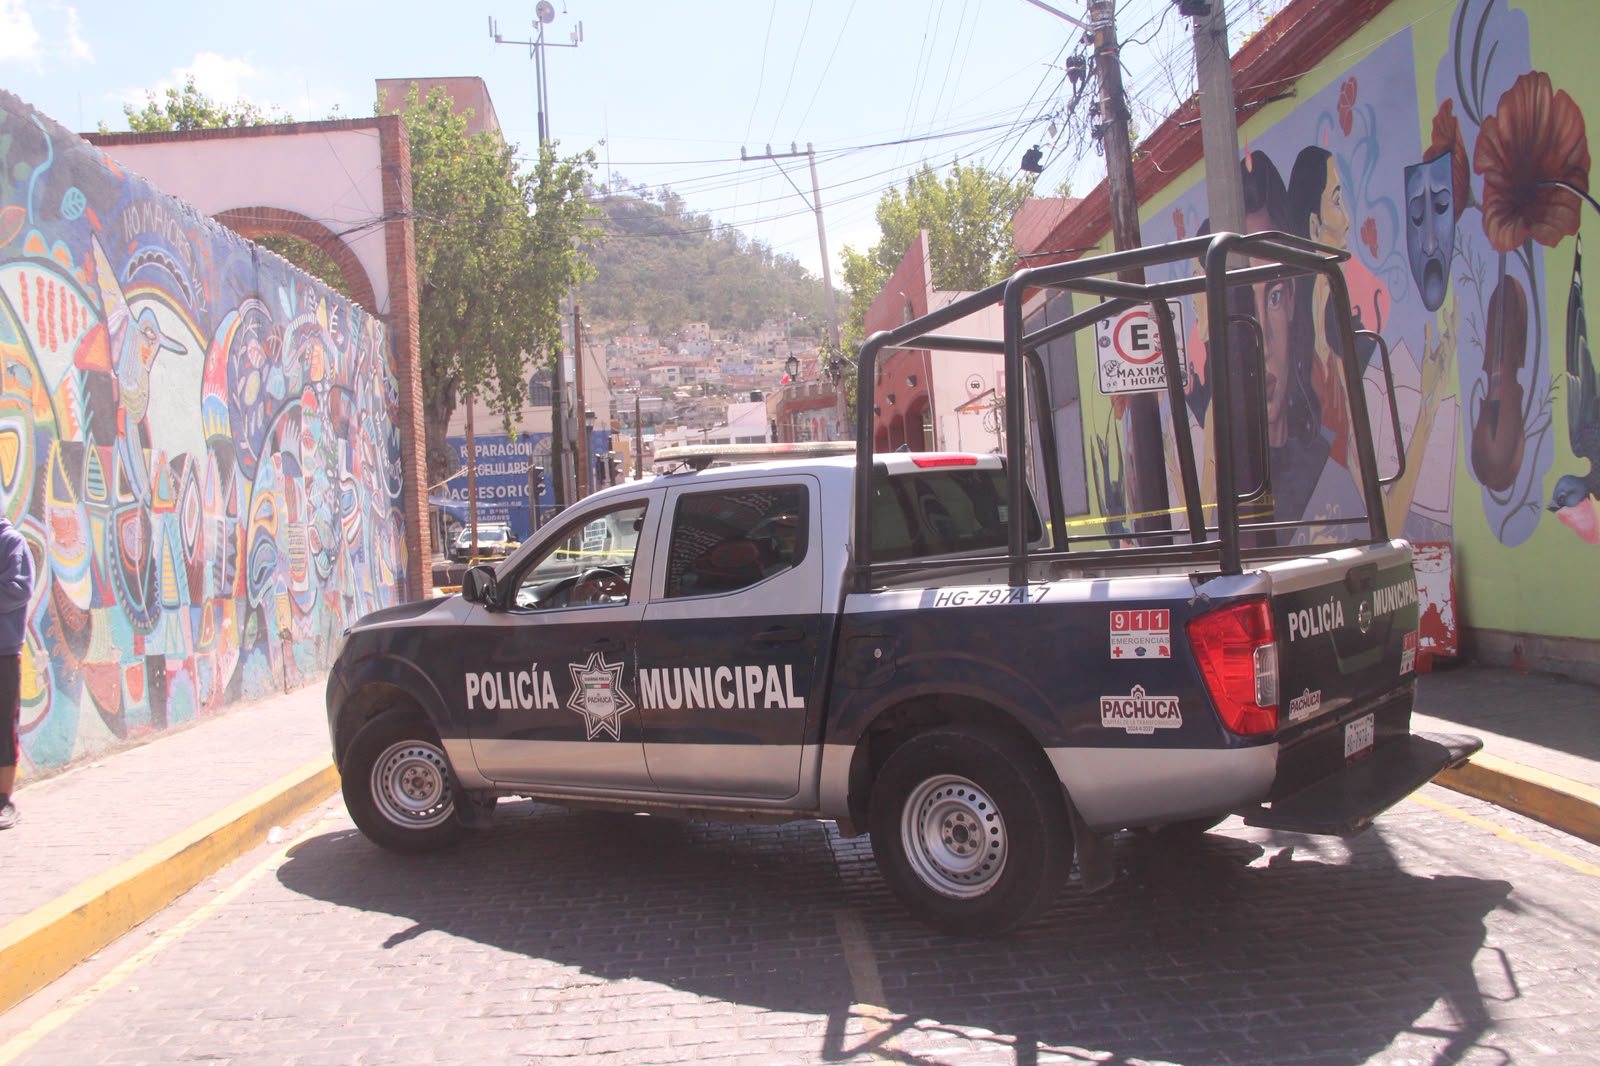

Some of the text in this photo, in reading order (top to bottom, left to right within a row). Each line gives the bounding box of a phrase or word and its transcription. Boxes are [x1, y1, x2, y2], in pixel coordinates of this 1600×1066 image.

[123, 206, 140, 243] NO
[1131, 324, 1150, 351] E
[460, 443, 532, 458] RPARACION
[451, 484, 546, 500] ACESORIS
[935, 587, 1051, 607] HG-797A-7
[1287, 578, 1418, 642] POLICÍA MUNICIPAL
[1111, 637, 1169, 645] EMERGENCIAS
[465, 663, 805, 710] POLICÍA MUNICIPAL
[1102, 701, 1180, 719] PACHUCA
[1290, 692, 1320, 714] PACHUCA
